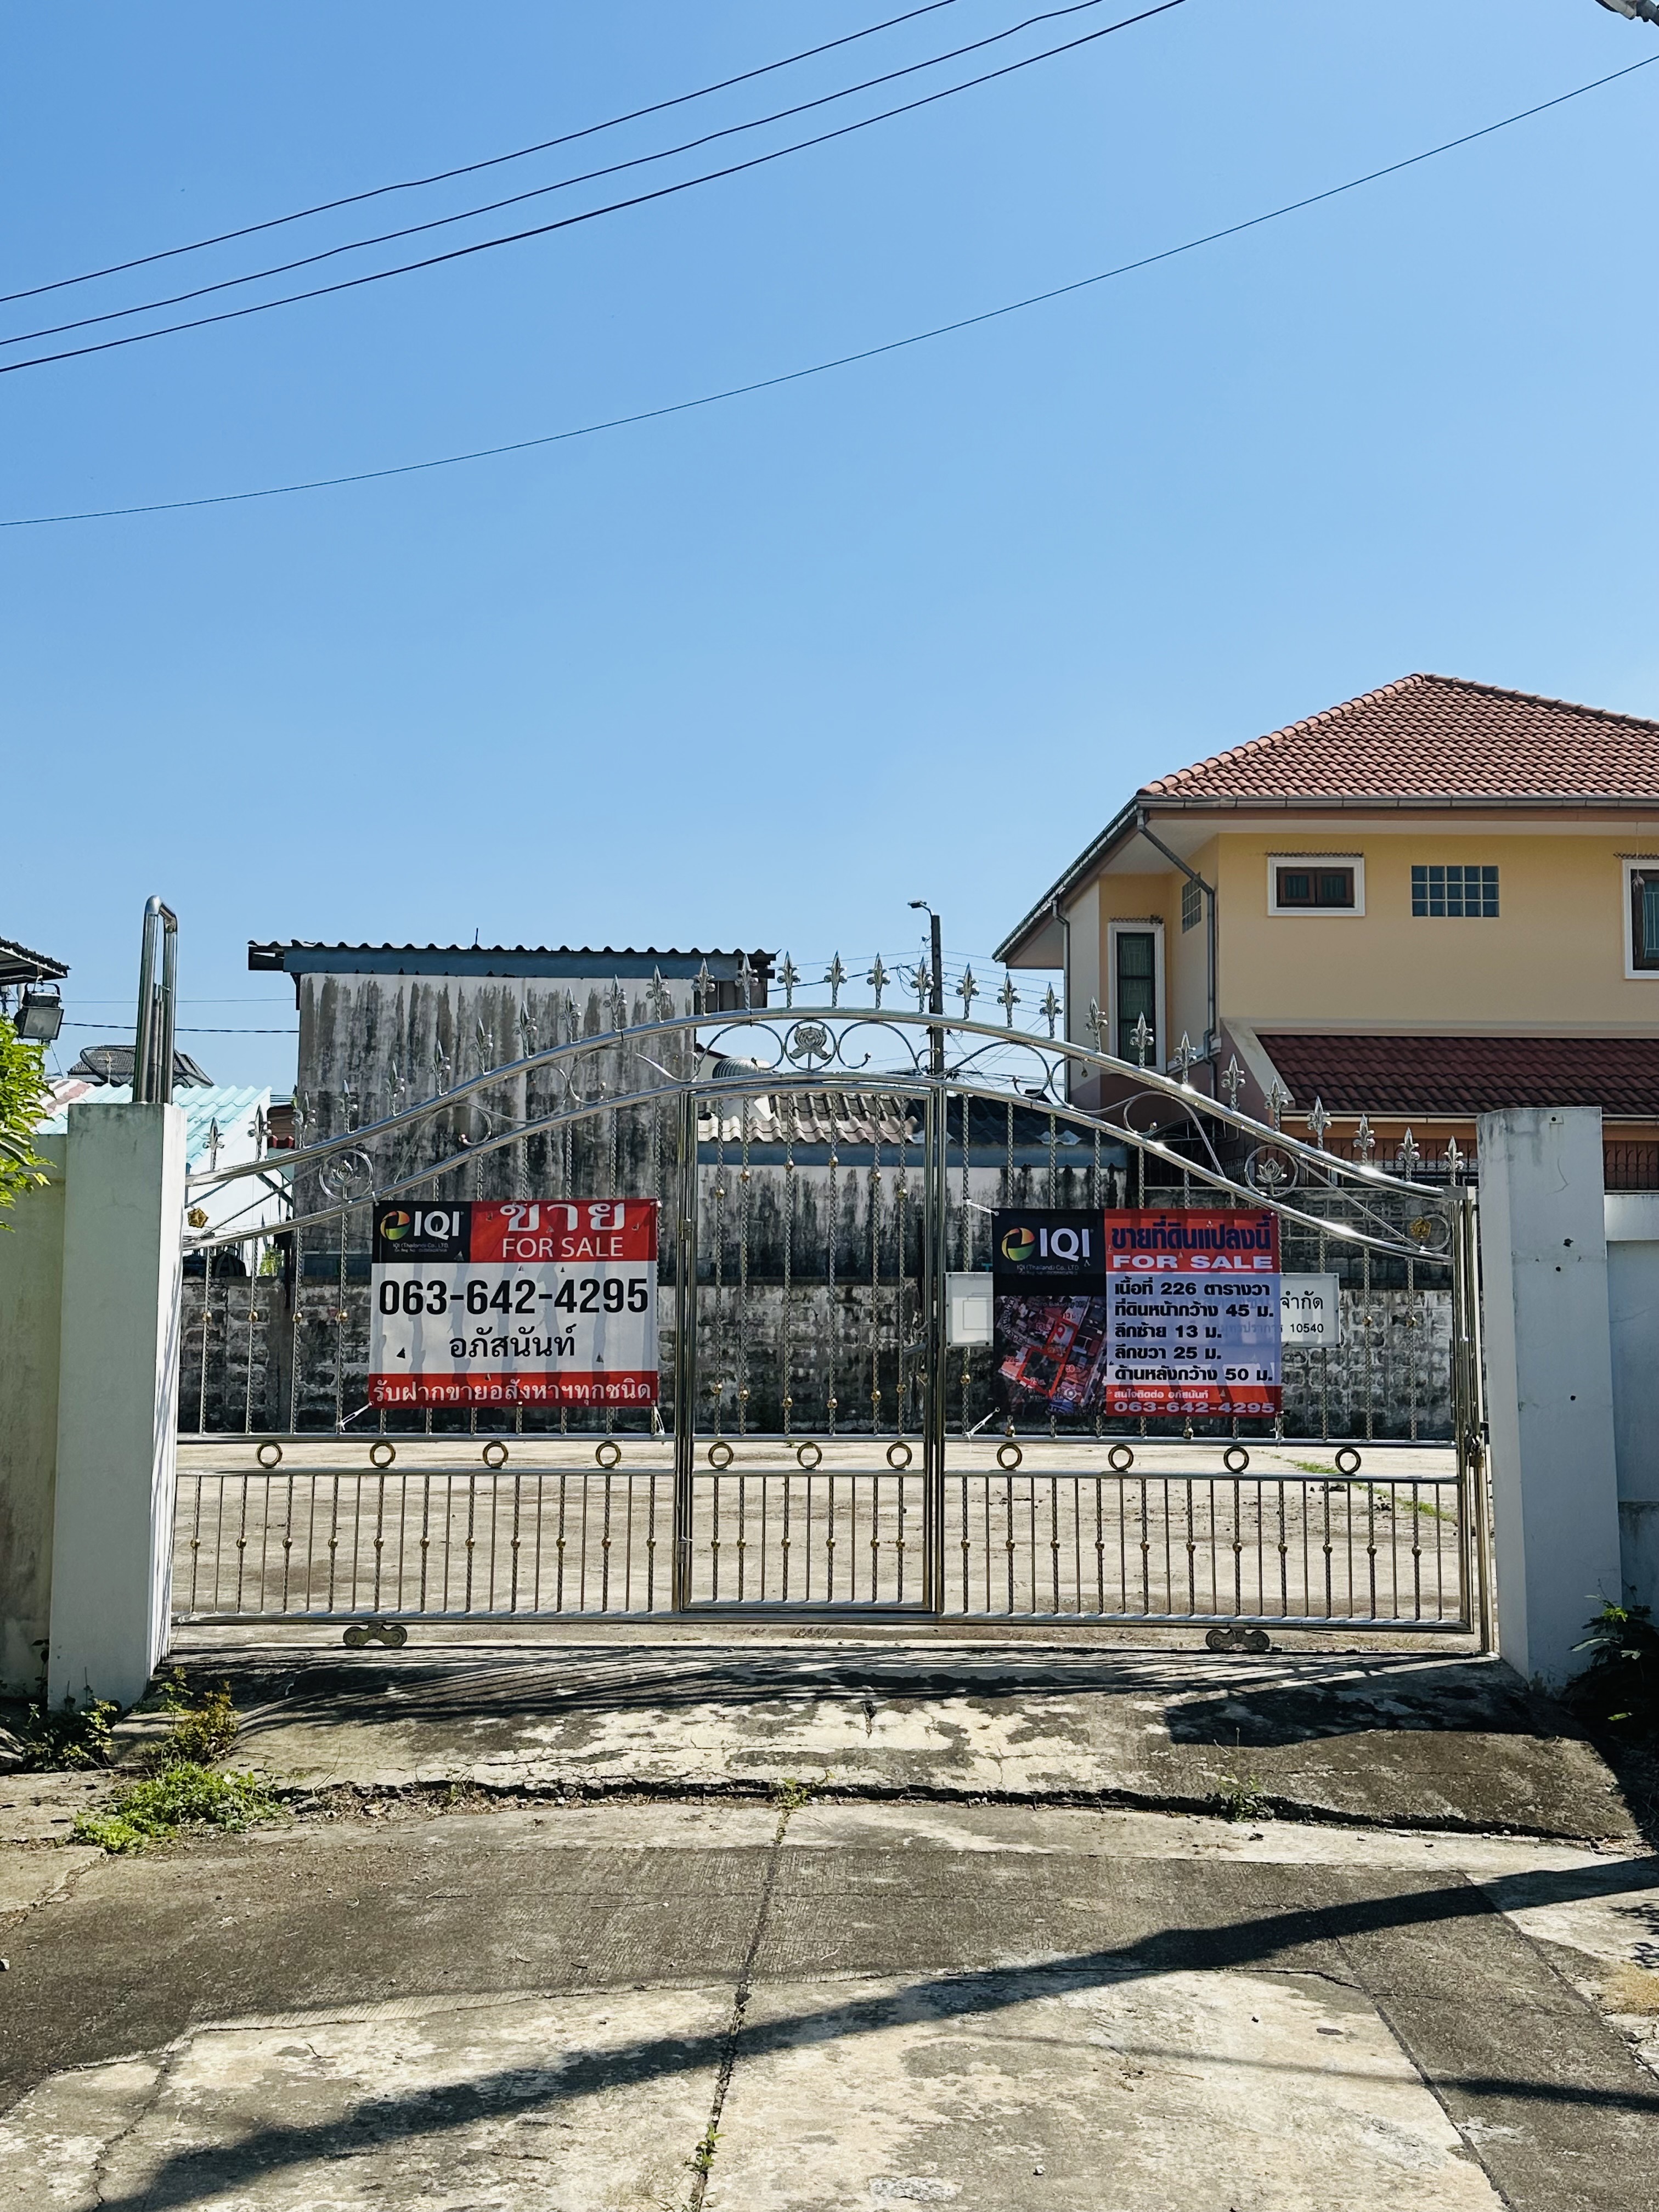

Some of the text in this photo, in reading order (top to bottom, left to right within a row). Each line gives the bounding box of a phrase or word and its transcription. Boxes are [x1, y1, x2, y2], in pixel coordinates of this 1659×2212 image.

[414, 1211, 460, 1240] IQI
[500, 1203, 625, 1232] ขาย
[1111, 1215, 1272, 1250] ขายที่ดินแปลงนี้
[503, 1237, 624, 1259] FOR SALE
[1040, 1228, 1090, 1262] IQI
[1113, 1255, 1273, 1269] FOR SALE
[379, 1278, 648, 1315] 063-642-4295
[1115, 1276, 1270, 1296] เนื้อที่ 226 ตารางวา
[1115, 1298, 1218, 1317] ที่ดินหน้ากว้าง
[1225, 1304, 1250, 1317] 45
[1257, 1305, 1274, 1317] ม.
[1115, 1322, 1222, 1339] ลึกซ้าย 13 ม.
[1290, 1323, 1324, 1333] 10540
[450, 1323, 577, 1358] อภัสนันท์
[1115, 1344, 1222, 1359] ลึกขวา 25 ม.
[1115, 1365, 1273, 1381] ด้านหลังกว้าง 50 ม.
[373, 1378, 651, 1406] รับฝากขายอสังหาฯทุกชนิด
[1114, 1401, 1275, 1414] 063-642-4295
